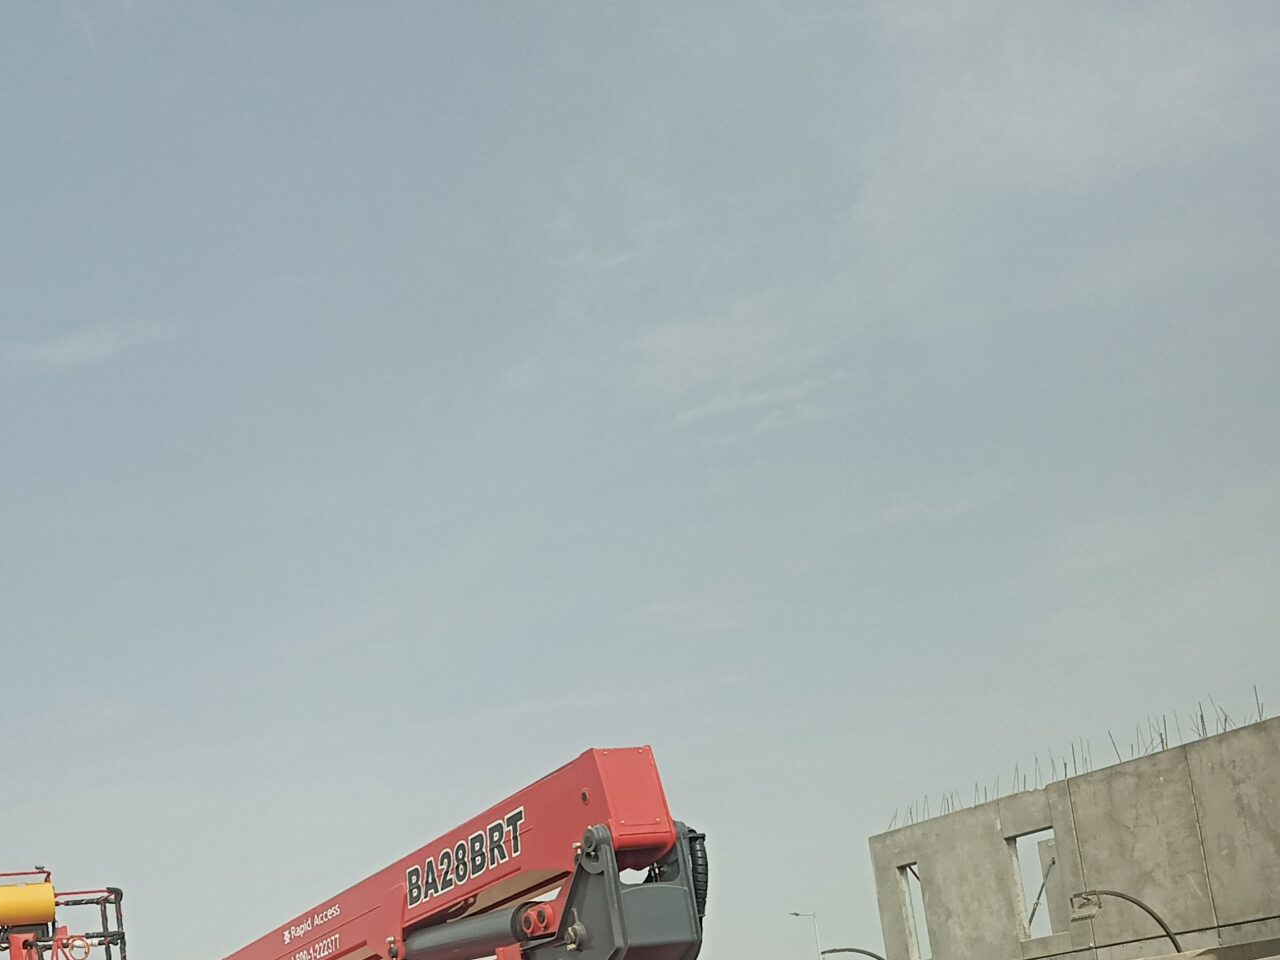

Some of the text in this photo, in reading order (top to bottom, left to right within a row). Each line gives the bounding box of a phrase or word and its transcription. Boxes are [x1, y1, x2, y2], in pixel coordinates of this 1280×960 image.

[406, 805, 525, 909] BA28BRT
[290, 904, 340, 939] Rapid Access
